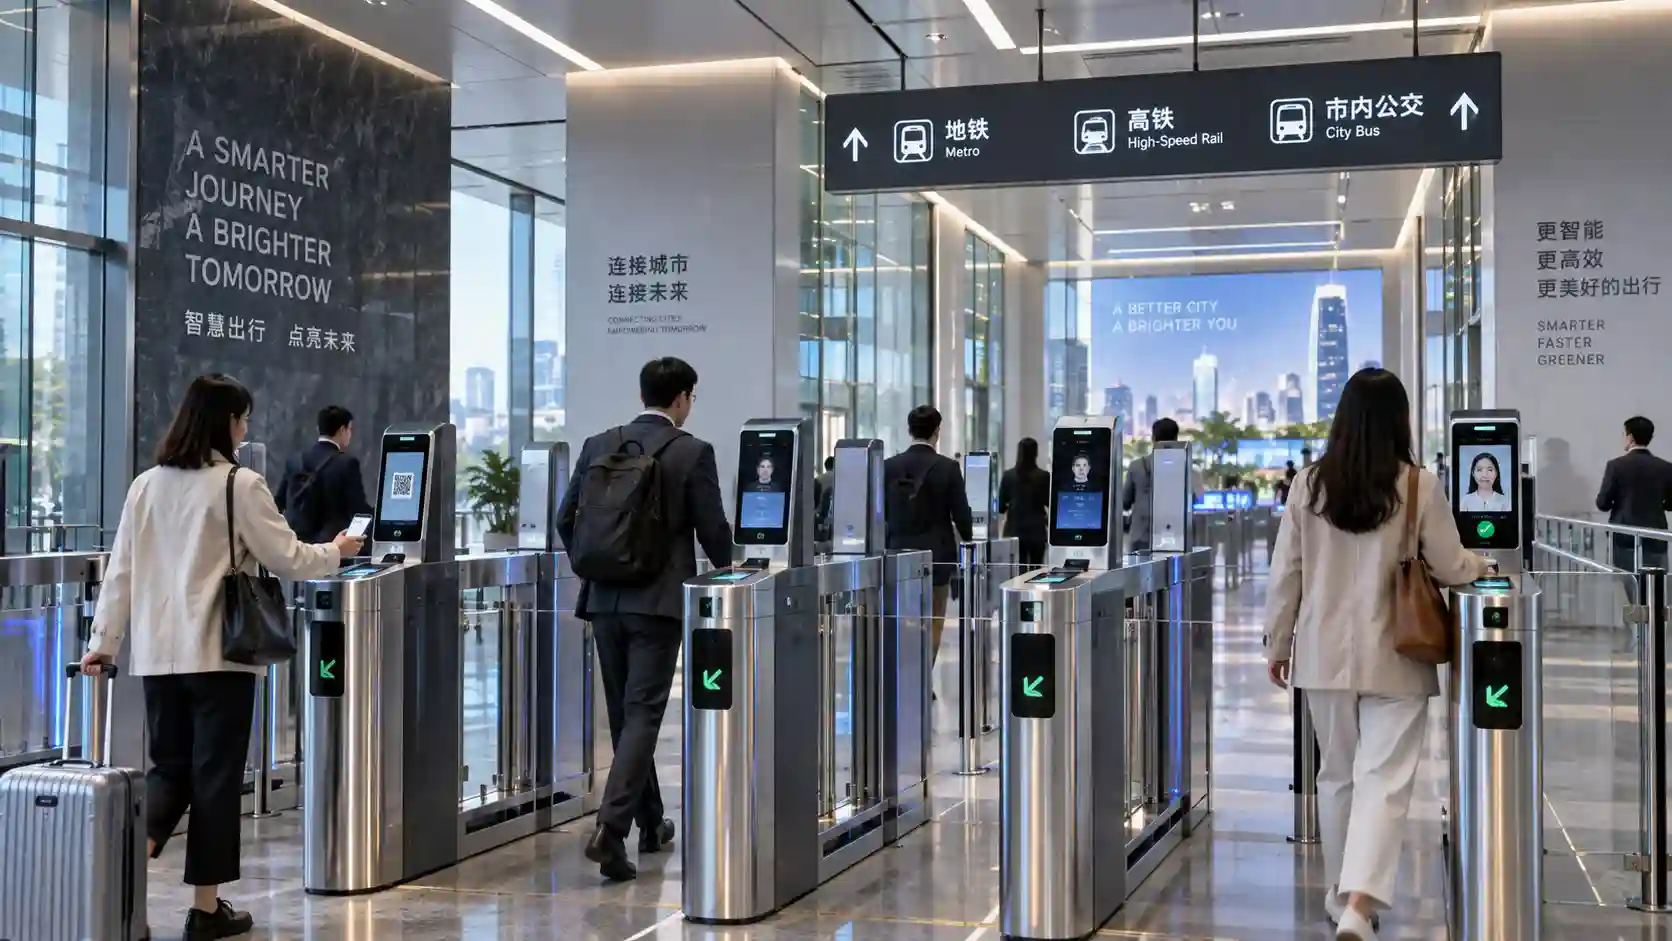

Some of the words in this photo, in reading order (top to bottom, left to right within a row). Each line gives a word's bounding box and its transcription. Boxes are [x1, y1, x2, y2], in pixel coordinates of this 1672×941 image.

[1325, 92, 1425, 121] 市内公交
[945, 117, 989, 141] 地铁
[1128, 107, 1175, 132] 高铁
[1128, 134, 1197, 149] High-Speed
[1202, 132, 1224, 145] Rail
[1326, 126, 1351, 140] City
[1356, 125, 1381, 137] Bus
[186, 129, 205, 159] A
[214, 136, 329, 191] SMARTER
[945, 146, 980, 158] Metro
[185, 171, 303, 221] JOURNEY
[185, 212, 203, 243] A
[214, 217, 332, 267] BRIGHTER
[1536, 219, 1604, 242] 更智能
[608, 253, 689, 276] 连接城市
[1536, 248, 1604, 270] 更高效
[185, 253, 332, 304] TOMORROW
[1537, 275, 1661, 299] 更美好的出行
[608, 281, 689, 304] 连接未来
[1128, 301, 1181, 315] BETTER
[1186, 300, 1218, 314] CITY
[184, 309, 266, 343] 智慧出行
[288, 323, 356, 353] 点亮未来
[1112, 320, 1123, 334] A
[1128, 319, 1201, 334] BRIGHTER
[1207, 317, 1237, 331] YOU
[1537, 319, 1605, 332] SMARTER
[1537, 336, 1592, 349] FASTER
[1537, 353, 1605, 366] GREENER
